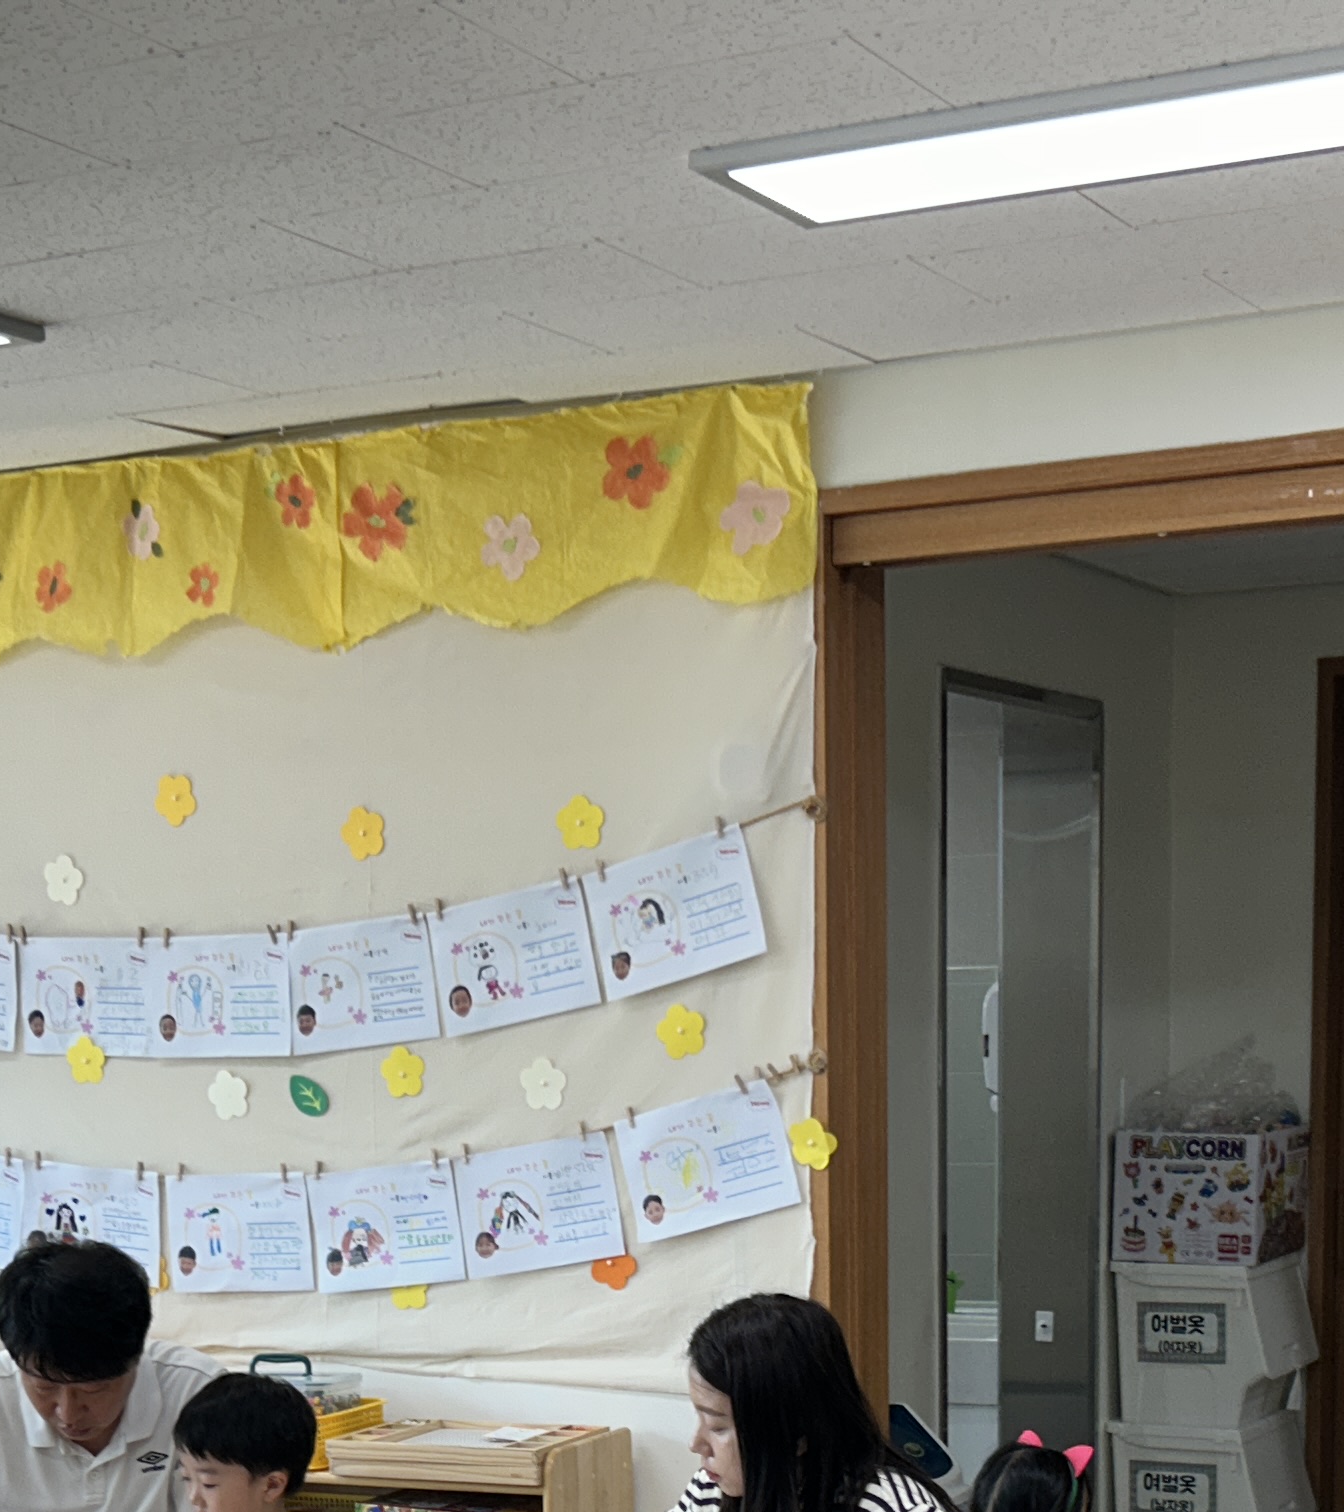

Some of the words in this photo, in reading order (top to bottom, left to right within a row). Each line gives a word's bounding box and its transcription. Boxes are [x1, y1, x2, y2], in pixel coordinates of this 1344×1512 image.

[1130, 1134, 1247, 1161] PLAYCORN
[1151, 1314, 1205, 1335] 여벌옷
[1158, 1340, 1202, 1354] (여자옷)
[1143, 1473, 1196, 1494] 여벌옷
